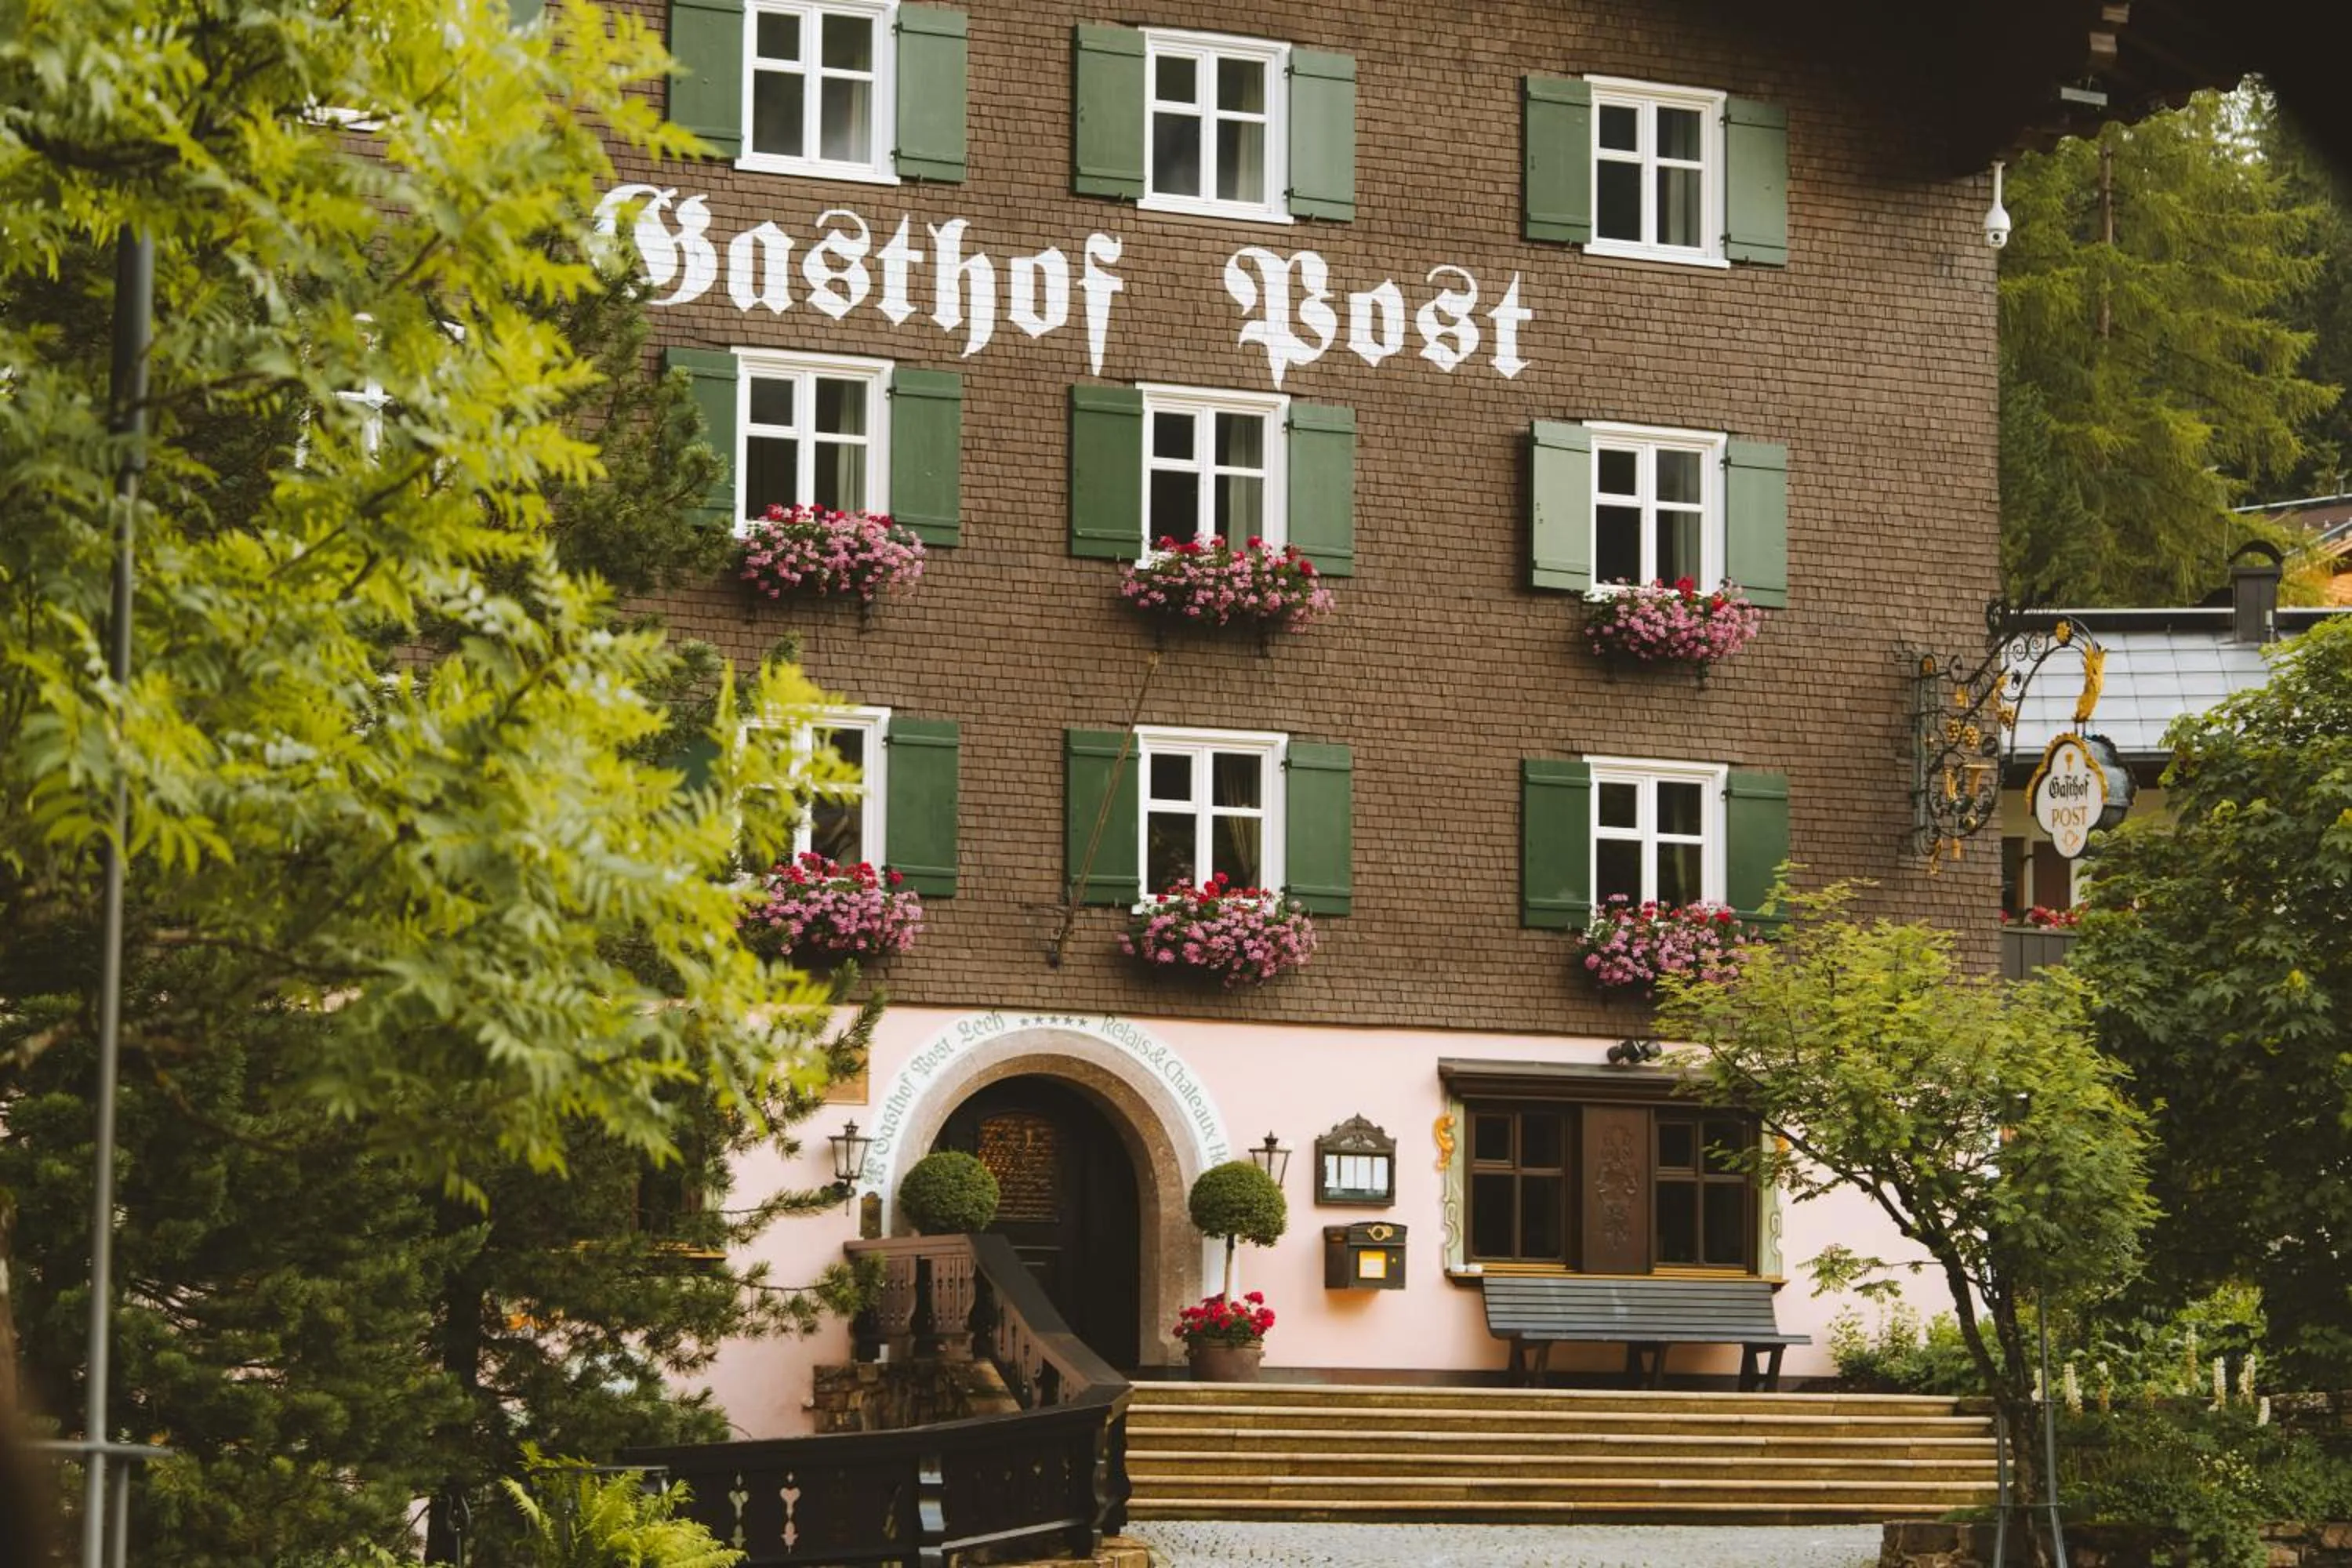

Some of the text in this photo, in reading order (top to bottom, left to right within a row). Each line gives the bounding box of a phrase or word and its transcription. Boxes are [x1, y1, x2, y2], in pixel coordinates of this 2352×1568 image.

[590, 183, 1533, 391] Gasthof Post
[2052, 805, 2089, 828] POST
[873, 1071, 918, 1156] Gasthof
[910, 1037, 955, 1076] Post
[957, 1010, 1004, 1044] Lech
